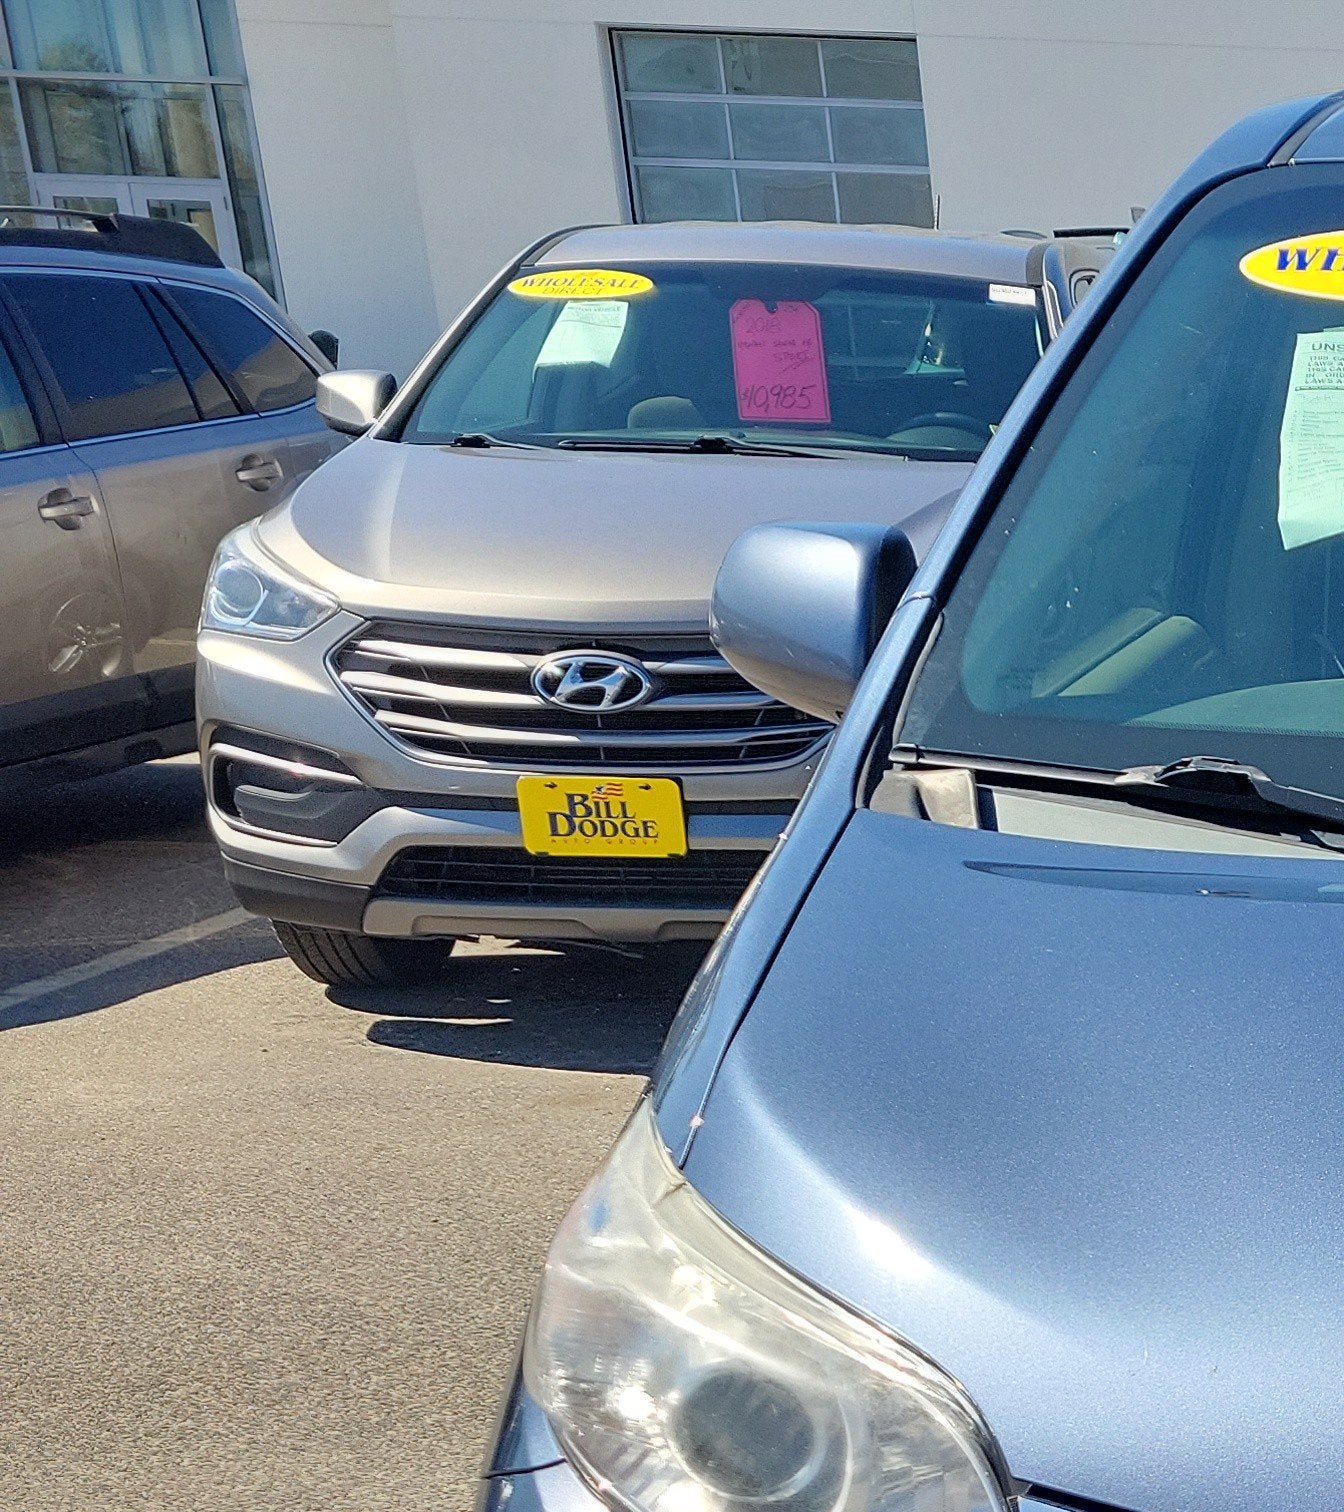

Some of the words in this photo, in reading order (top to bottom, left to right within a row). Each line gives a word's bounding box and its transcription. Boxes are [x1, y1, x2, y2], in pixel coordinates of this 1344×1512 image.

[521, 277, 643, 289] WHOLESALE
[542, 287, 605, 295] DIRECT
[740, 383, 817, 413] $10,985
